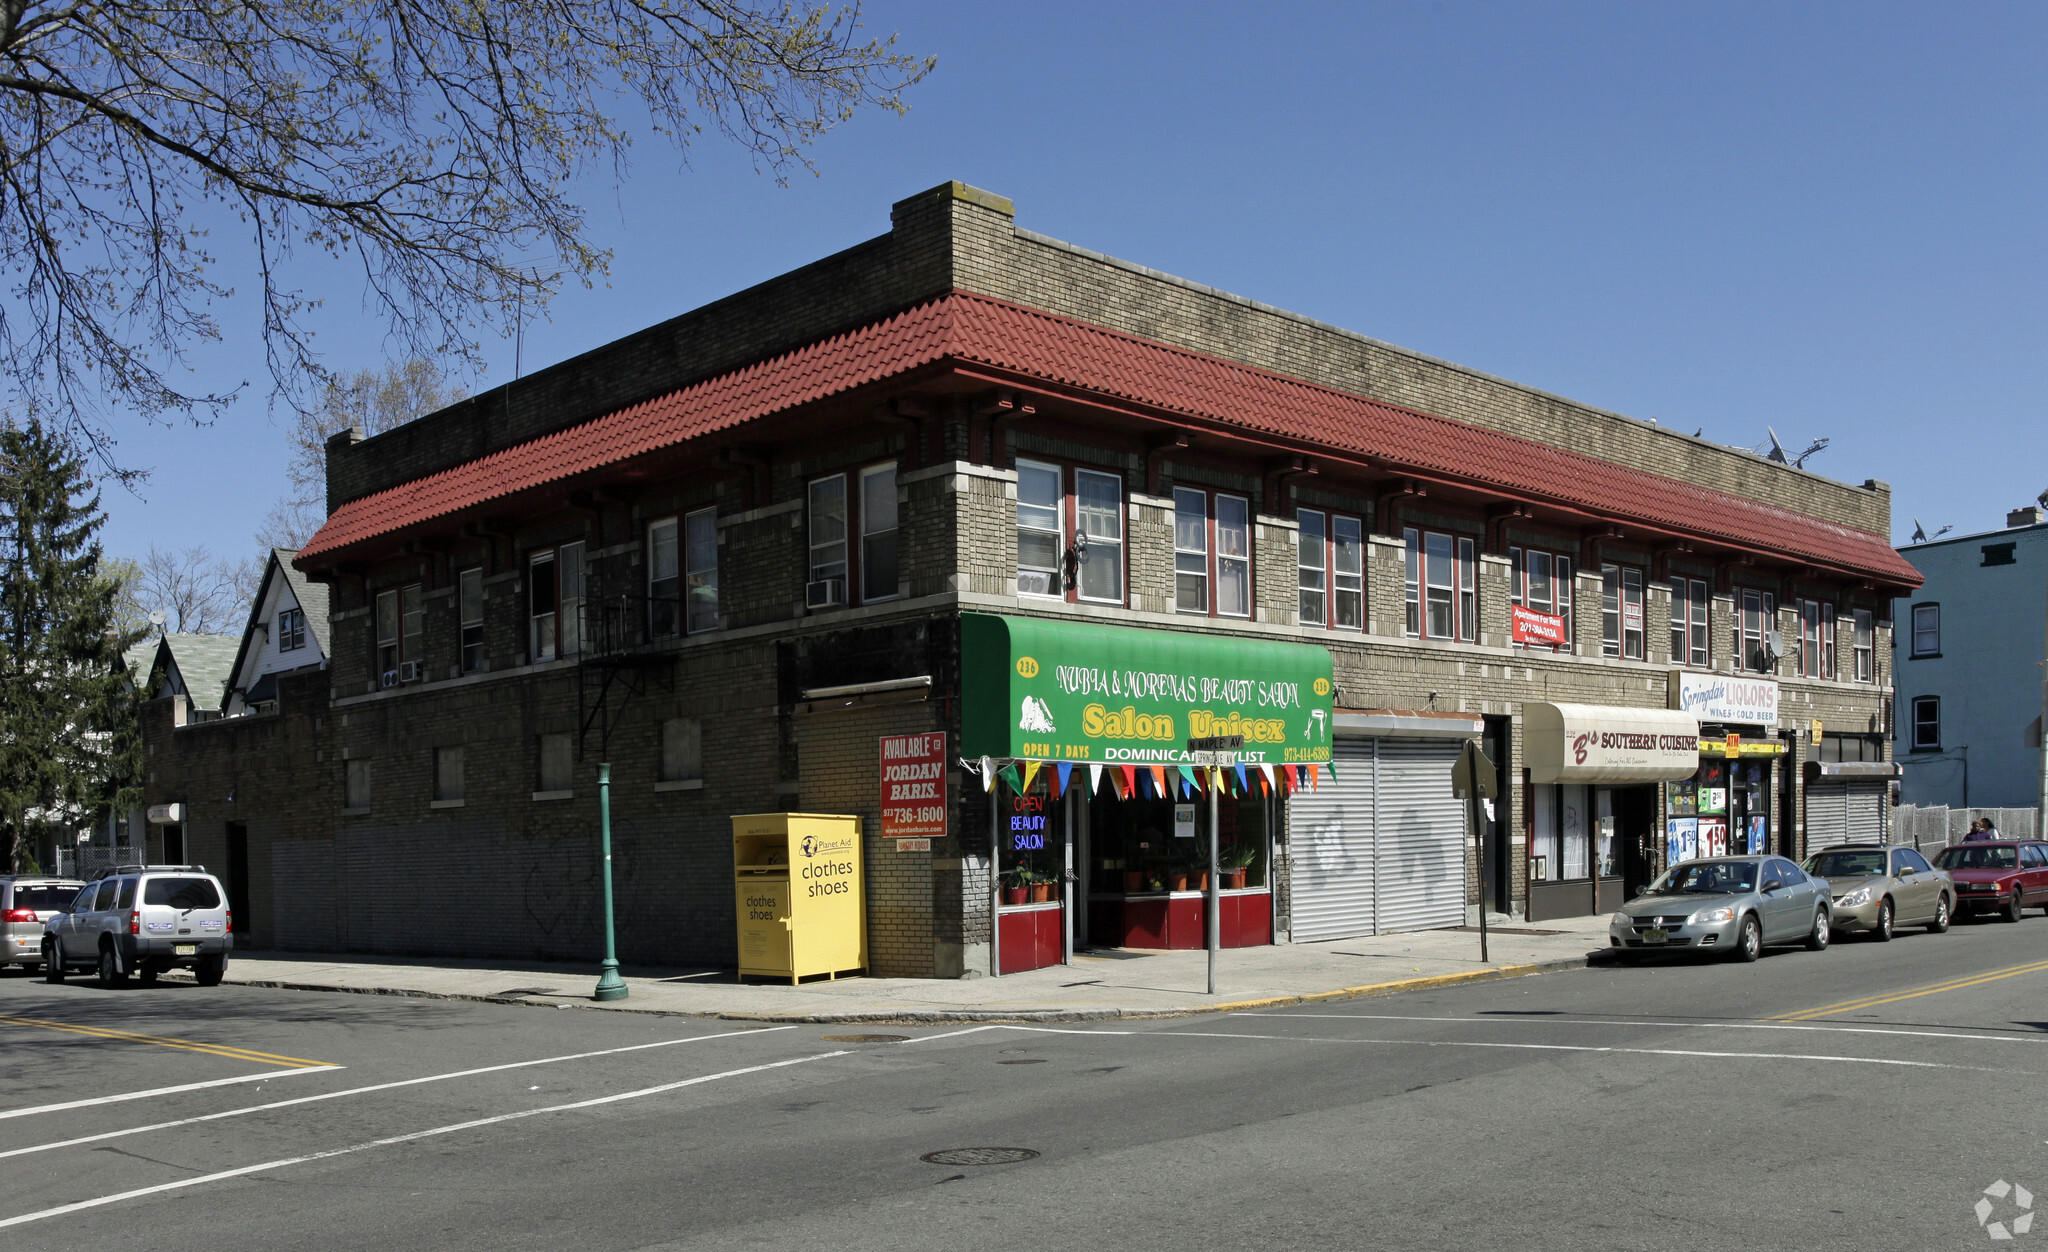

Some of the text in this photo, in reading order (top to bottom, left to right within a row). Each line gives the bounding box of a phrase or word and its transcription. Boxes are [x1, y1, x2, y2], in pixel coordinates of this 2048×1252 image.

[1514, 608, 1561, 627] Apartment For Rent
[1019, 660, 1036, 674] 236
[1055, 665, 1110, 697] NUBIA
[1111, 670, 1121, 695] &
[1200, 677, 1255, 705] BEAUTY
[1258, 681, 1300, 709] SALON
[1315, 681, 1328, 692] 236
[1680, 681, 1774, 713] Springdale LIQUORS
[1710, 708, 1774, 721] WINES COLD BEER
[1082, 702, 1286, 744] Salon Unisex
[884, 736, 930, 760] AVAILABLE
[1190, 736, 1241, 750] N MAPLE AV
[1601, 732, 1657, 750] SOUTHERN
[1659, 734, 1698, 751] CUISINE
[1727, 734, 1740, 747] ATM
[1023, 742, 1090, 758] OPEN 7 DAYS
[1105, 747, 1195, 762] DOMINICA
[1284, 747, 1330, 762] 973-414-6388
[1197, 752, 1223, 765] SPRINGALE
[883, 762, 942, 782] JORDAN
[890, 782, 936, 801] BARIS
[1014, 796, 1044, 811] OPEN
[884, 806, 944, 824] 973 736-1600
[1011, 815, 1046, 830] BEAUTY
[885, 825, 942, 835] www.jordanbaris.com
[818, 838, 851, 849] Planet Aid
[1014, 834, 1044, 850] SALON
[802, 860, 853, 879] clothes
[808, 880, 849, 898] shoes
[746, 895, 776, 907] clothes
[750, 909, 774, 921] shoes
